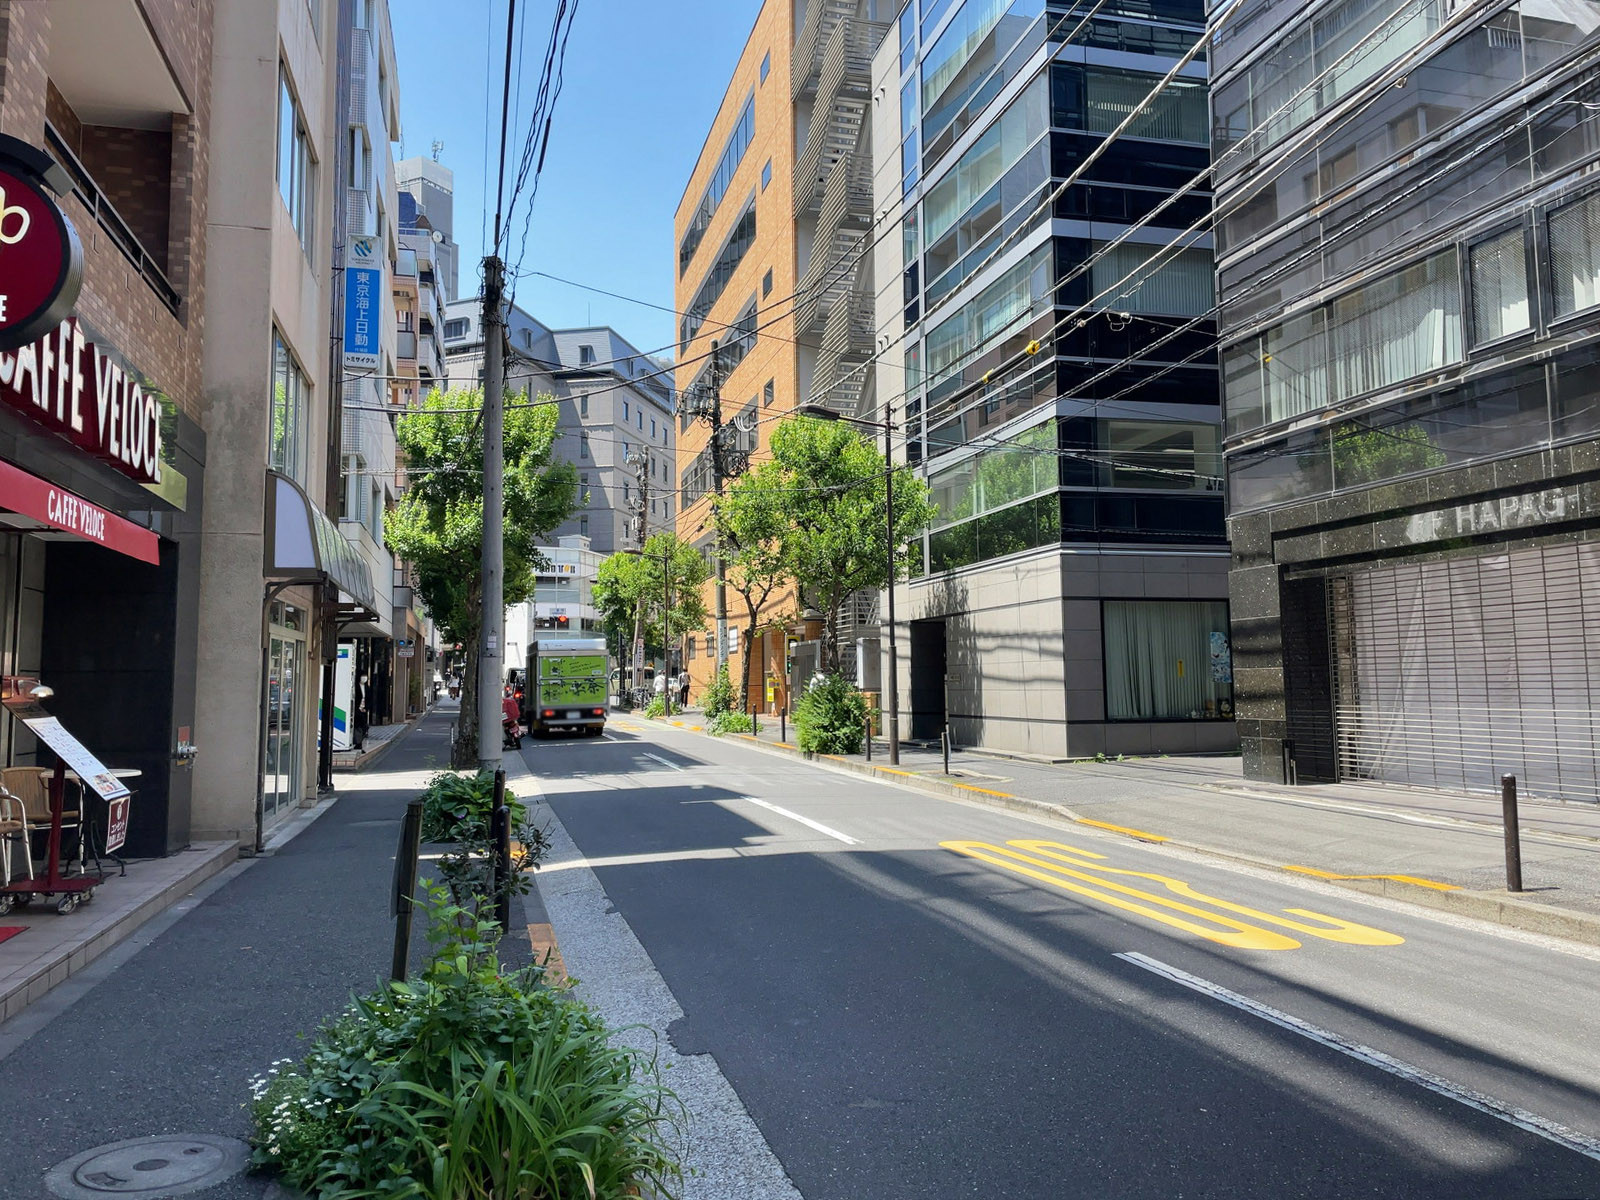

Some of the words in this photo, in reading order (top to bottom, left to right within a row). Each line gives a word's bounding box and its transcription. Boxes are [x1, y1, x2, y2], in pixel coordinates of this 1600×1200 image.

[355, 271, 370, 346] 東京海上日動
[346, 356, 376, 364] トミサイクル
[93, 345, 163, 484] VELOCE
[79, 501, 105, 541] VELOCE
